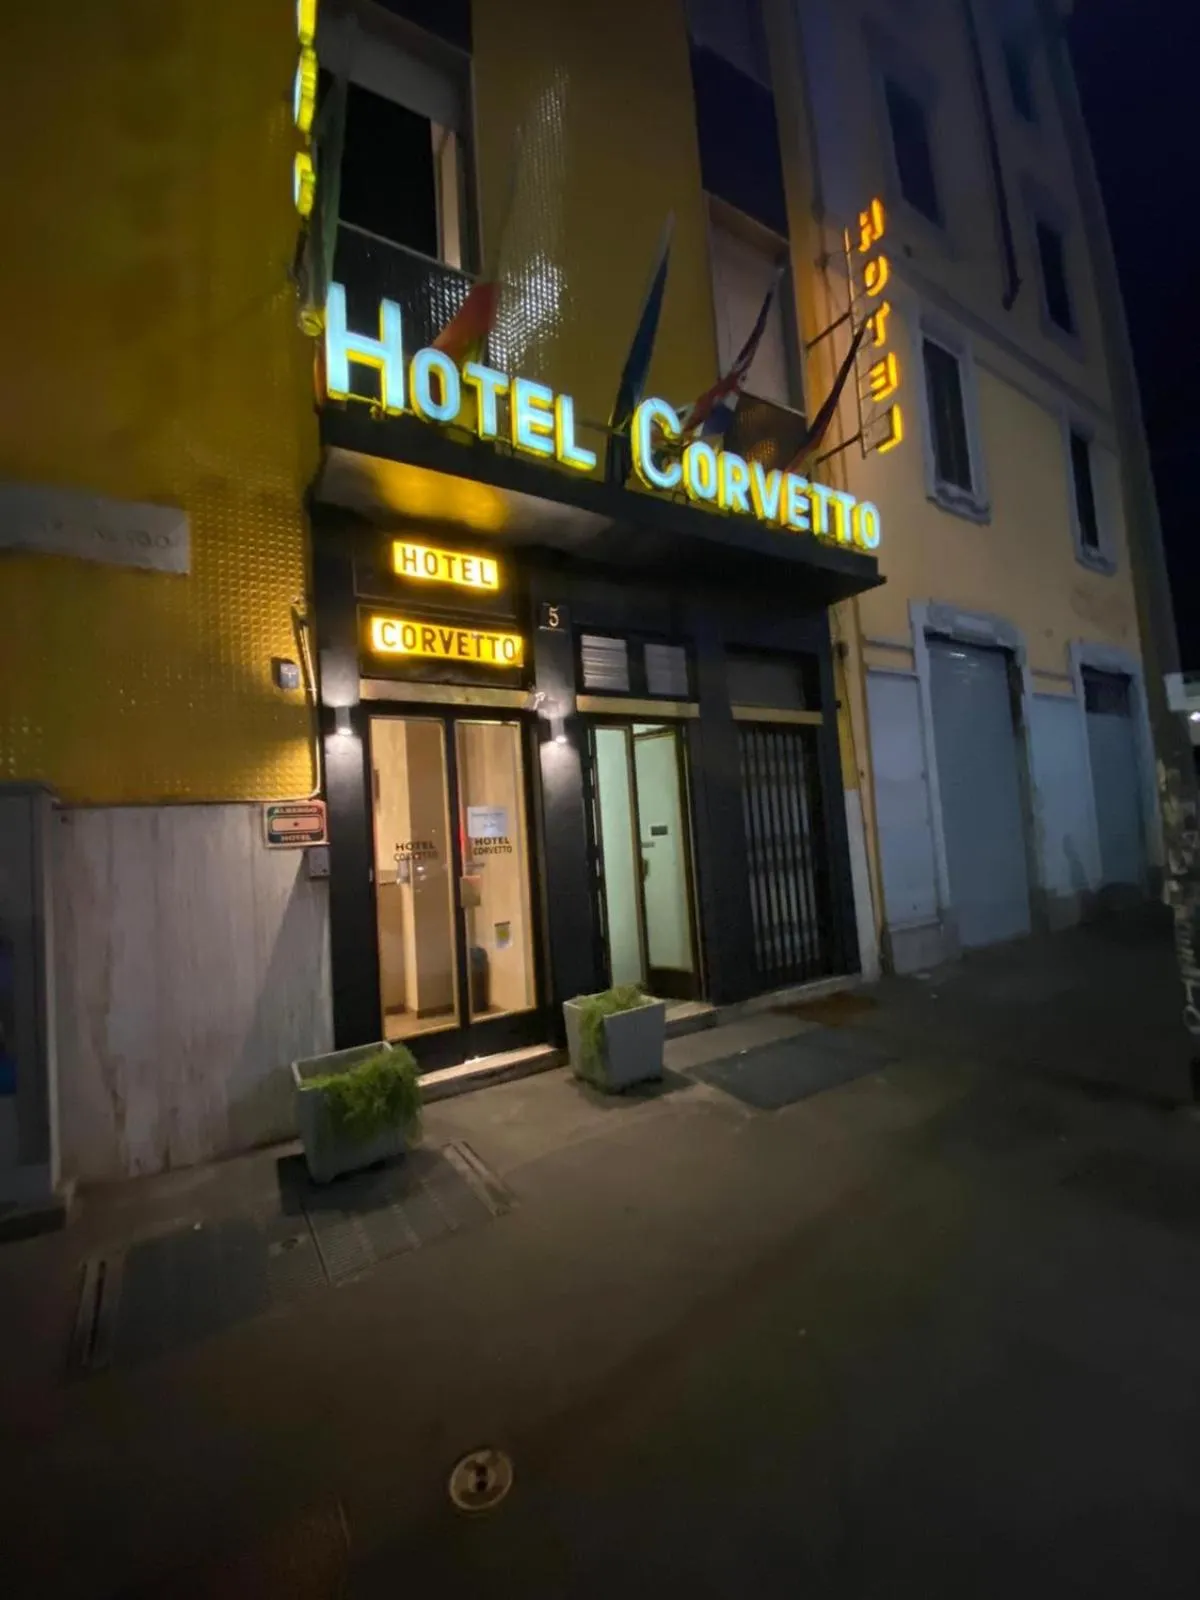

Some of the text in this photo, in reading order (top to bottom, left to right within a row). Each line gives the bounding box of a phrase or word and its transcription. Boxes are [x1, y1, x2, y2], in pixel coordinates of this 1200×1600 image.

[859, 197, 903, 453] HOTEL
[324, 280, 881, 550] HOTEL CORVETTO
[400, 546, 492, 586] HOTEL
[547, 606, 560, 628] 5
[380, 621, 516, 661] CORVETTO
[395, 841, 436, 851] HOTEL
[473, 845, 513, 855] CORVETTO
[474, 836, 510, 846] HOTEL
